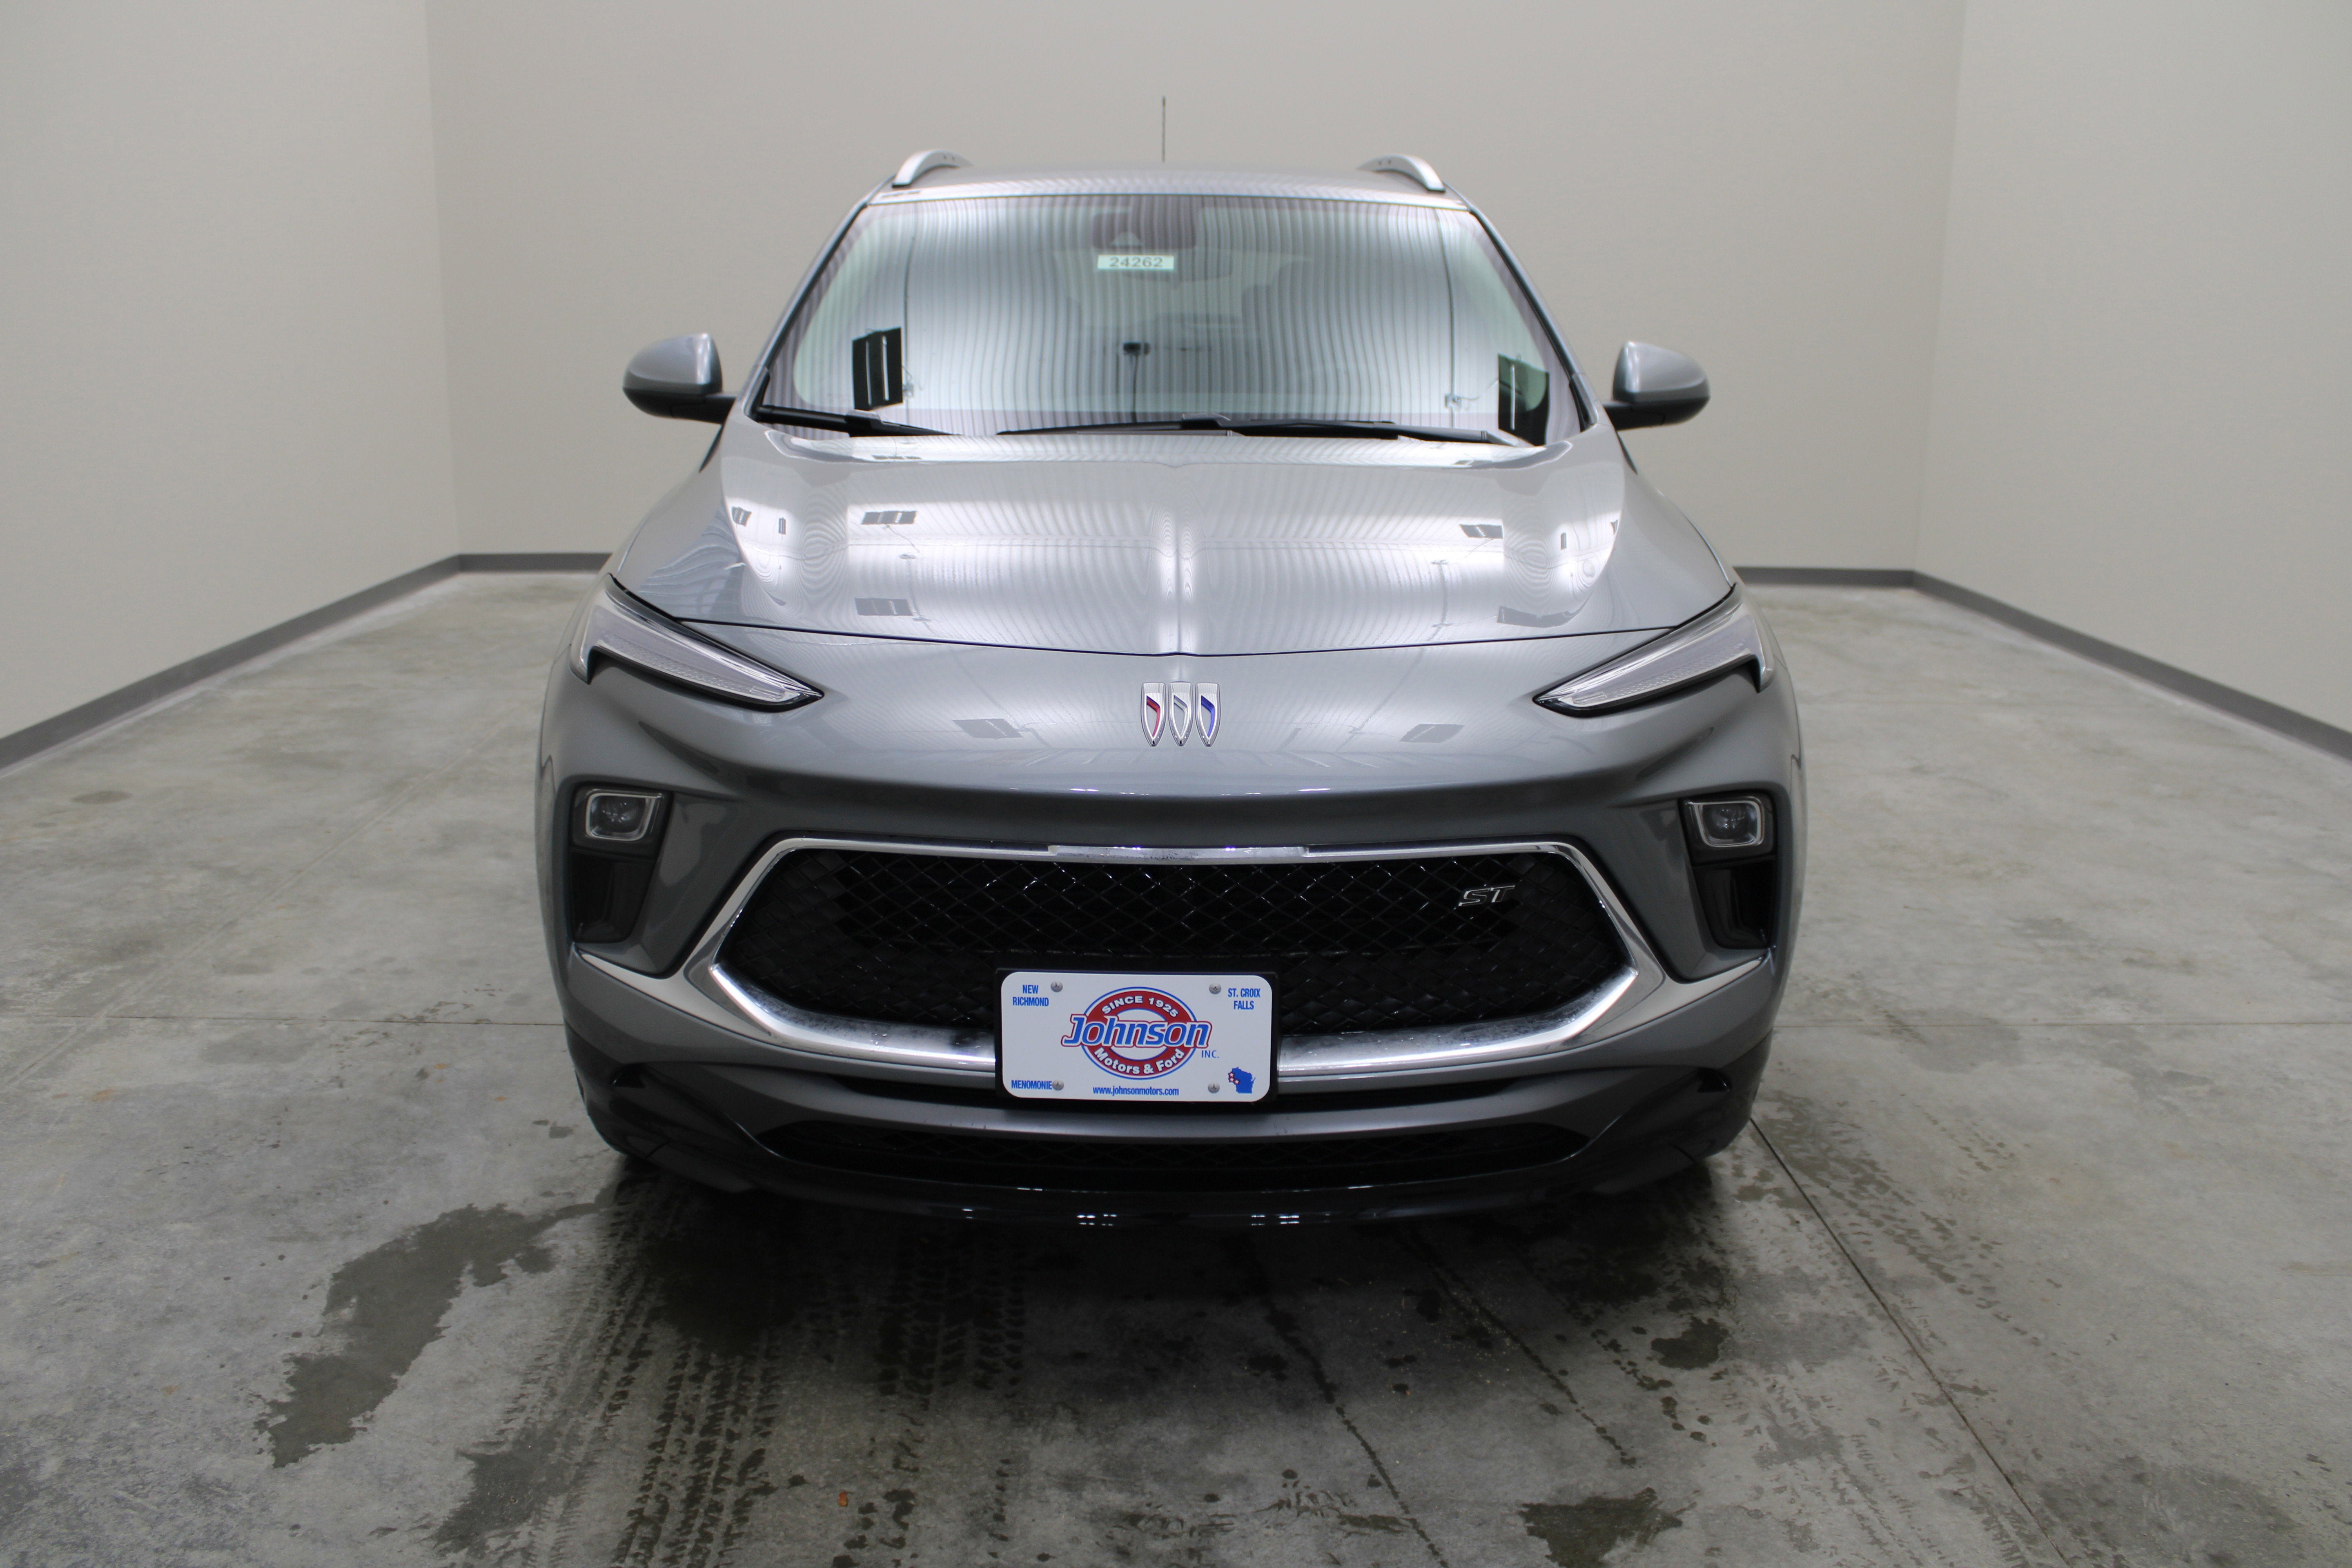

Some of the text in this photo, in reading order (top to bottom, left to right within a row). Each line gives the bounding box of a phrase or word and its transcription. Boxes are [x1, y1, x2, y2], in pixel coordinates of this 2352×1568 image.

[1109, 256, 1163, 267] 24262
[1458, 885, 1515, 906] ST
[1022, 984, 1039, 994] NEW
[1228, 988, 1261, 998] ST. CROIX
[1012, 997, 1049, 1006] RICHMOND
[1234, 1000, 1254, 1010] FALLS
[1101, 996, 1179, 1018] SINCE 1925
[1063, 1016, 1209, 1046] Johnson
[1201, 1050, 1219, 1058] INC.
[1094, 1047, 1185, 1074] Motors & Ford
[1011, 1080, 1052, 1090] MENOMONIE
[1093, 1086, 1179, 1096] www.johnsonmotors.com
